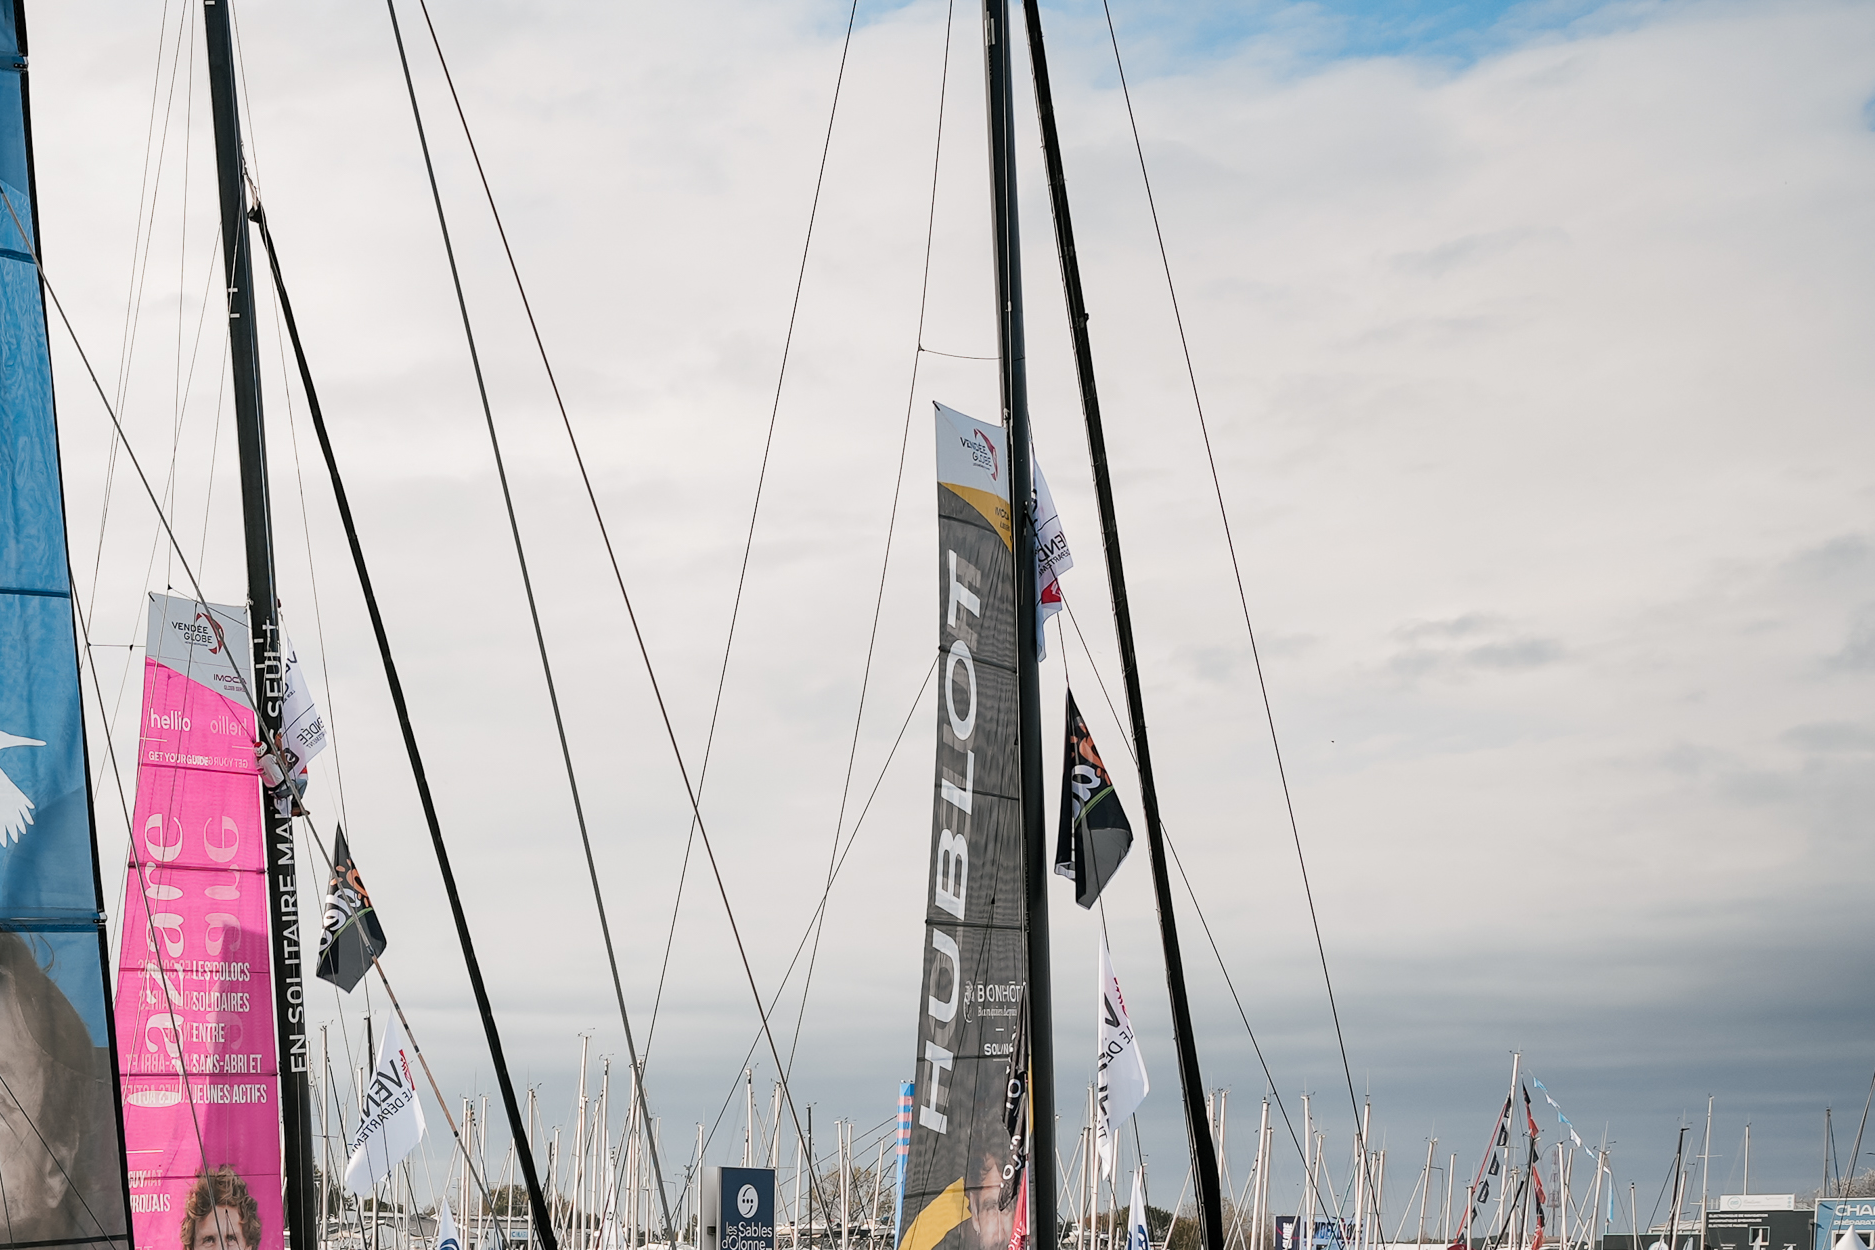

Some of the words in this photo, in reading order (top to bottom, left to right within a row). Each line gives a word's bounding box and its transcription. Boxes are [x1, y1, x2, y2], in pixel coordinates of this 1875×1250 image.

[171, 620, 209, 635] VENDÉE
[183, 631, 213, 645] GLOBE
[150, 708, 192, 732] hellio
[918, 548, 981, 1134] HUBLOT
[193, 960, 211, 980] LES
[213, 961, 251, 982] COLOCS
[193, 991, 251, 1013] SOLIDAIRES
[193, 1022, 225, 1043] ENTRE
[192, 1053, 248, 1074] SANS-ABRI
[250, 1054, 263, 1074] ET
[192, 1084, 231, 1104] JEUNES
[232, 1084, 267, 1104] ACTIFS
[725, 1221, 738, 1236] les
[738, 1221, 773, 1238] Sables
